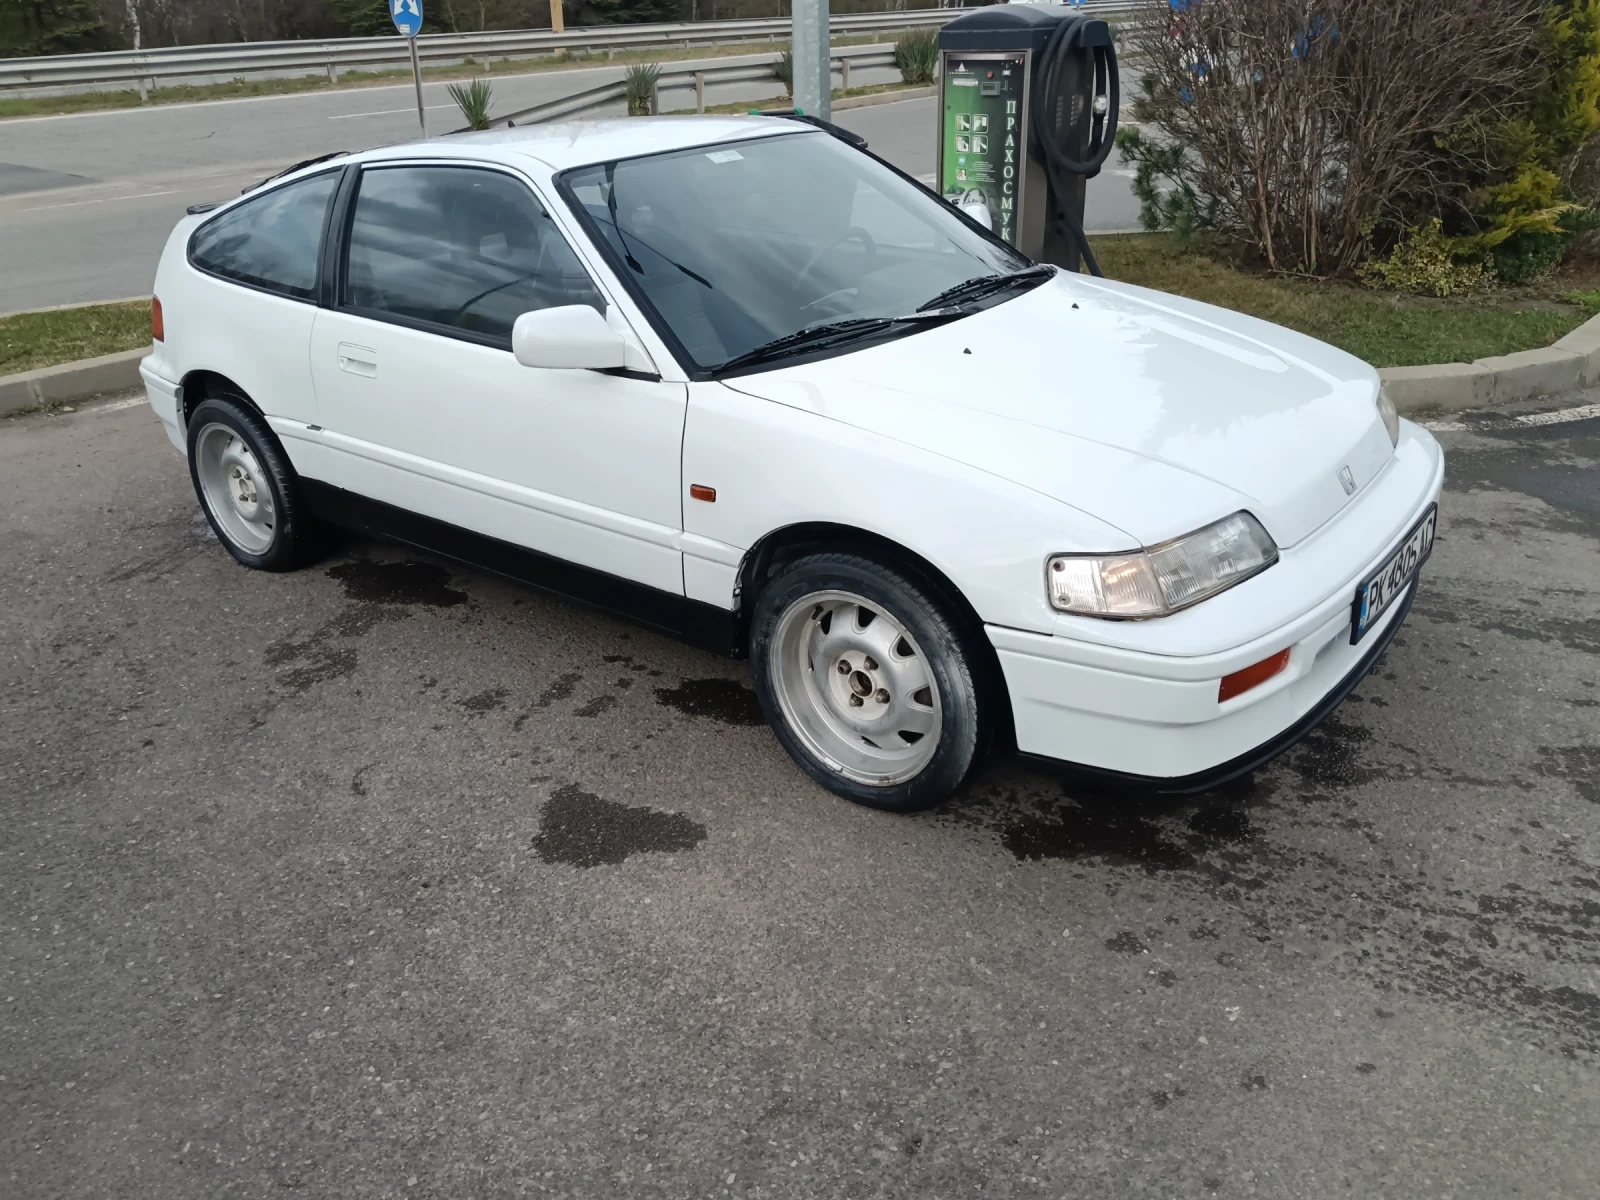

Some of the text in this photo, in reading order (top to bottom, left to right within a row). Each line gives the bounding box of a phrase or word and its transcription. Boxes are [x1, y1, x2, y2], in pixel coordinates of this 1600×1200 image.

[1001, 101, 1016, 240] ПРАХОСМУК
[1366, 569, 1388, 621] PK
[1387, 535, 1418, 595] 4805
